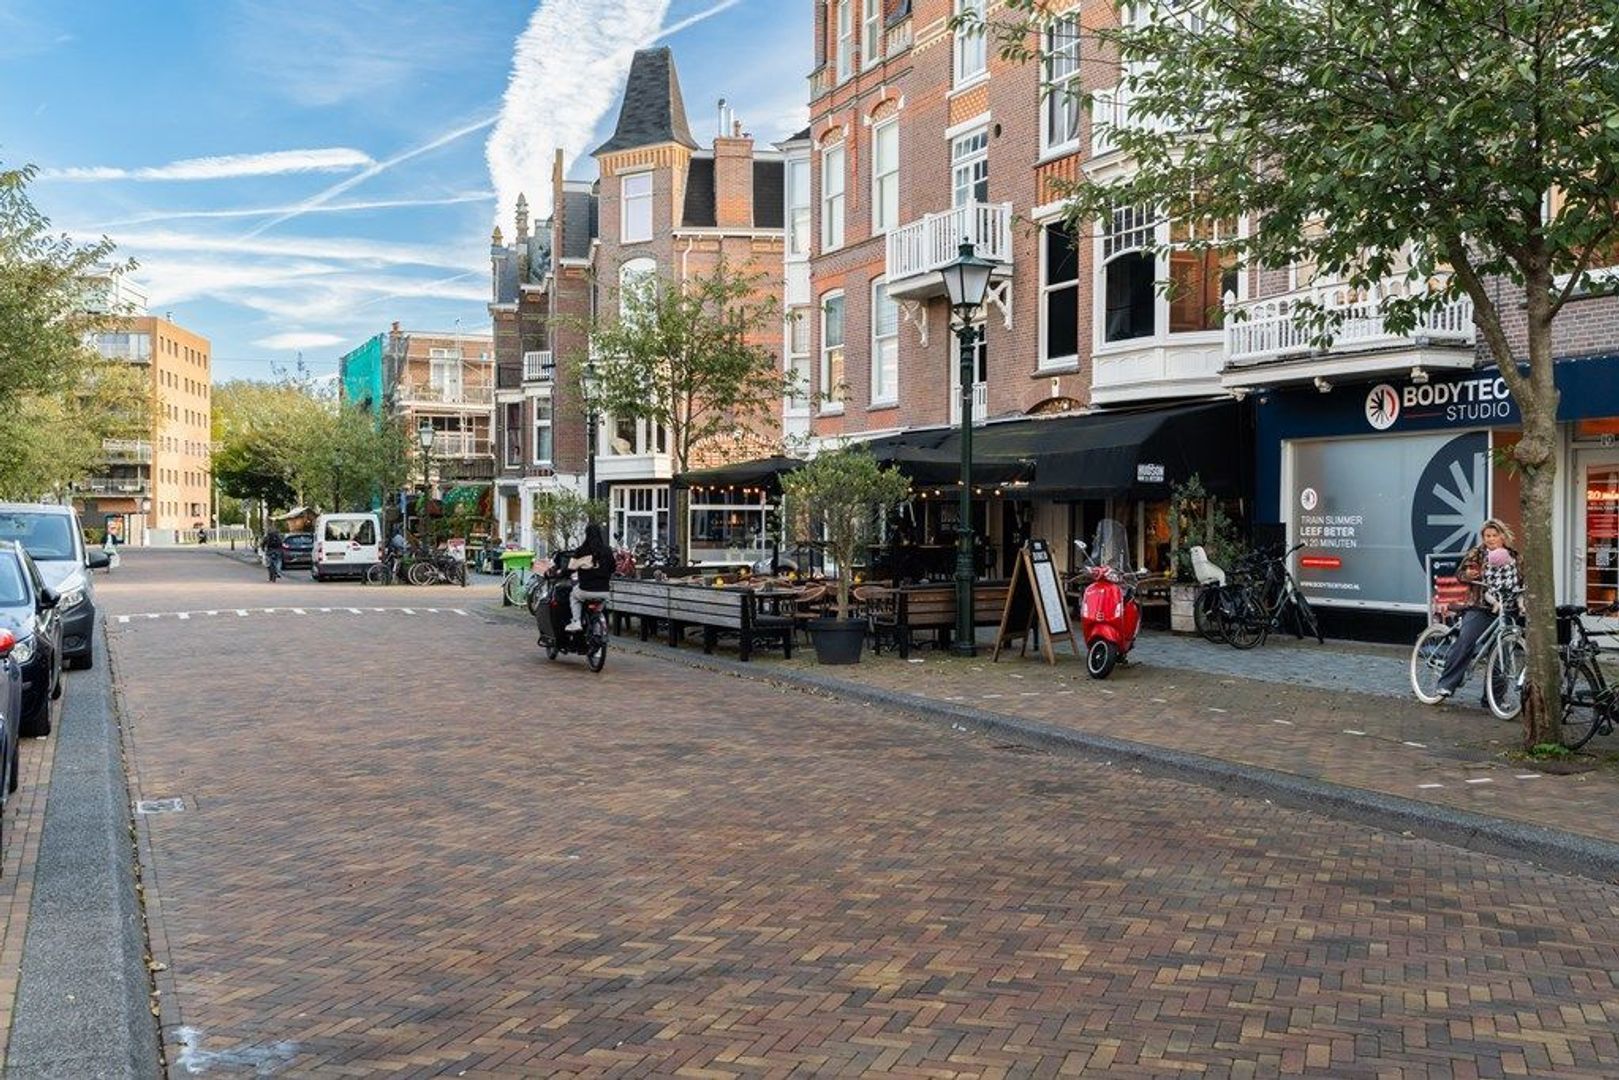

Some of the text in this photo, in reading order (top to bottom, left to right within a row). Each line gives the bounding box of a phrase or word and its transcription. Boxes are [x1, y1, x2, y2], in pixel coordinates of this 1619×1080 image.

[1403, 377, 1510, 407] BODYTEC
[1446, 401, 1510, 421] STUDIO
[1301, 515, 1325, 525] TRAIN
[1300, 526, 1355, 537] LEEF BETER
[1320, 538, 1357, 549] MINUTEN
